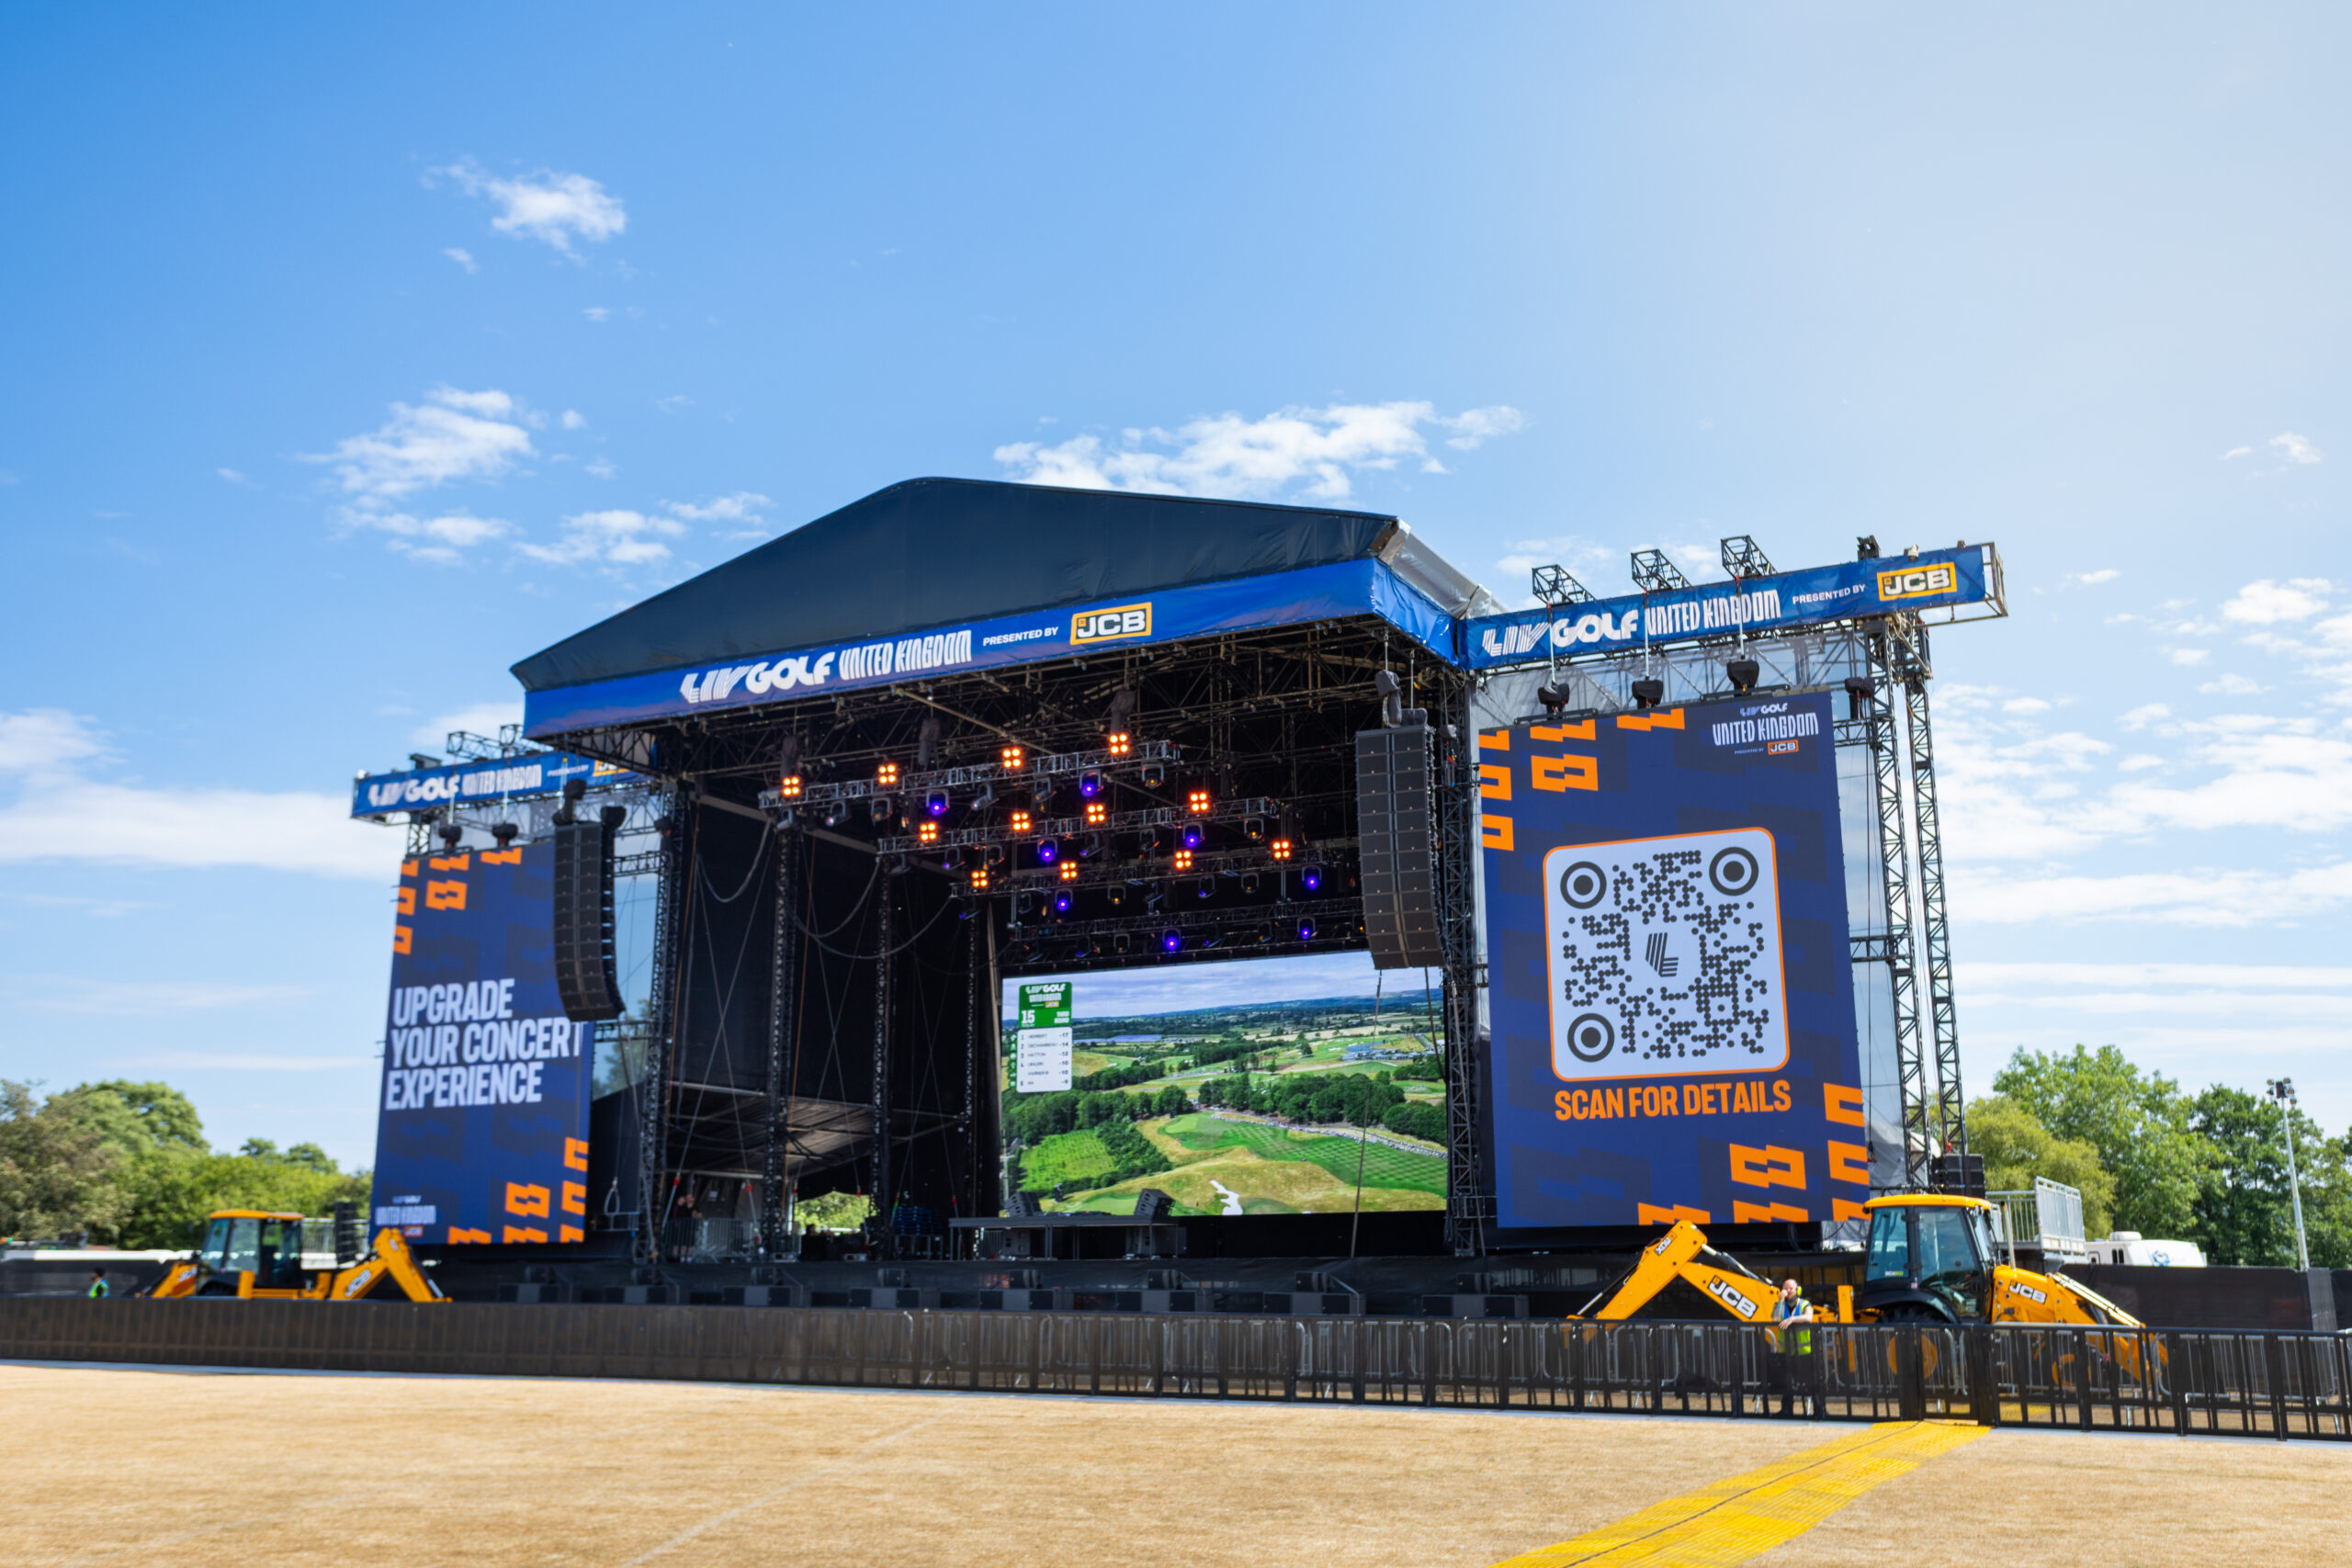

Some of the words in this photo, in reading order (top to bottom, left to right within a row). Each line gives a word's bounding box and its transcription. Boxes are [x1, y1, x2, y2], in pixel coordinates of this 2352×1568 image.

[1482, 622, 1550, 657] LIV
[1553, 609, 1638, 648] GOLF
[1646, 602, 1700, 636] UNITED
[1703, 590, 1781, 629] KINGDOM
[1792, 588, 1850, 604] PRESENTED
[1852, 584, 1865, 595] BY
[1884, 569, 1950, 595] JCB
[680, 664, 753, 704] LIV
[745, 651, 835, 694] GOLF
[839, 642, 893, 681] UNITED
[895, 630, 972, 672] KINGDOM
[983, 630, 1042, 647] PRESENTED
[1044, 626, 1058, 637] BY
[1077, 610, 1146, 638] JCB
[1760, 703, 1788, 715] GOLF
[1713, 718, 1755, 746] UNITED
[1758, 712, 1819, 741] KINGDOM
[1770, 742, 1796, 752] JCB
[404, 774, 459, 802] GOLF
[462, 770, 495, 796] UNITED
[393, 978, 514, 1027] UPGRADE
[1043, 984, 1066, 992] GOLF
[1022, 1010, 1035, 1023] 15
[390, 1025, 458, 1068] YOUR
[462, 1017, 588, 1063] CONCERT
[385, 1061, 544, 1111] EXPERIENCE
[1555, 1087, 1623, 1122] SCAN
[1629, 1084, 1679, 1118] FOR
[1683, 1079, 1792, 1115] DETAILS
[1709, 1280, 1758, 1318] JCB
[2008, 1280, 2047, 1304] JCB
